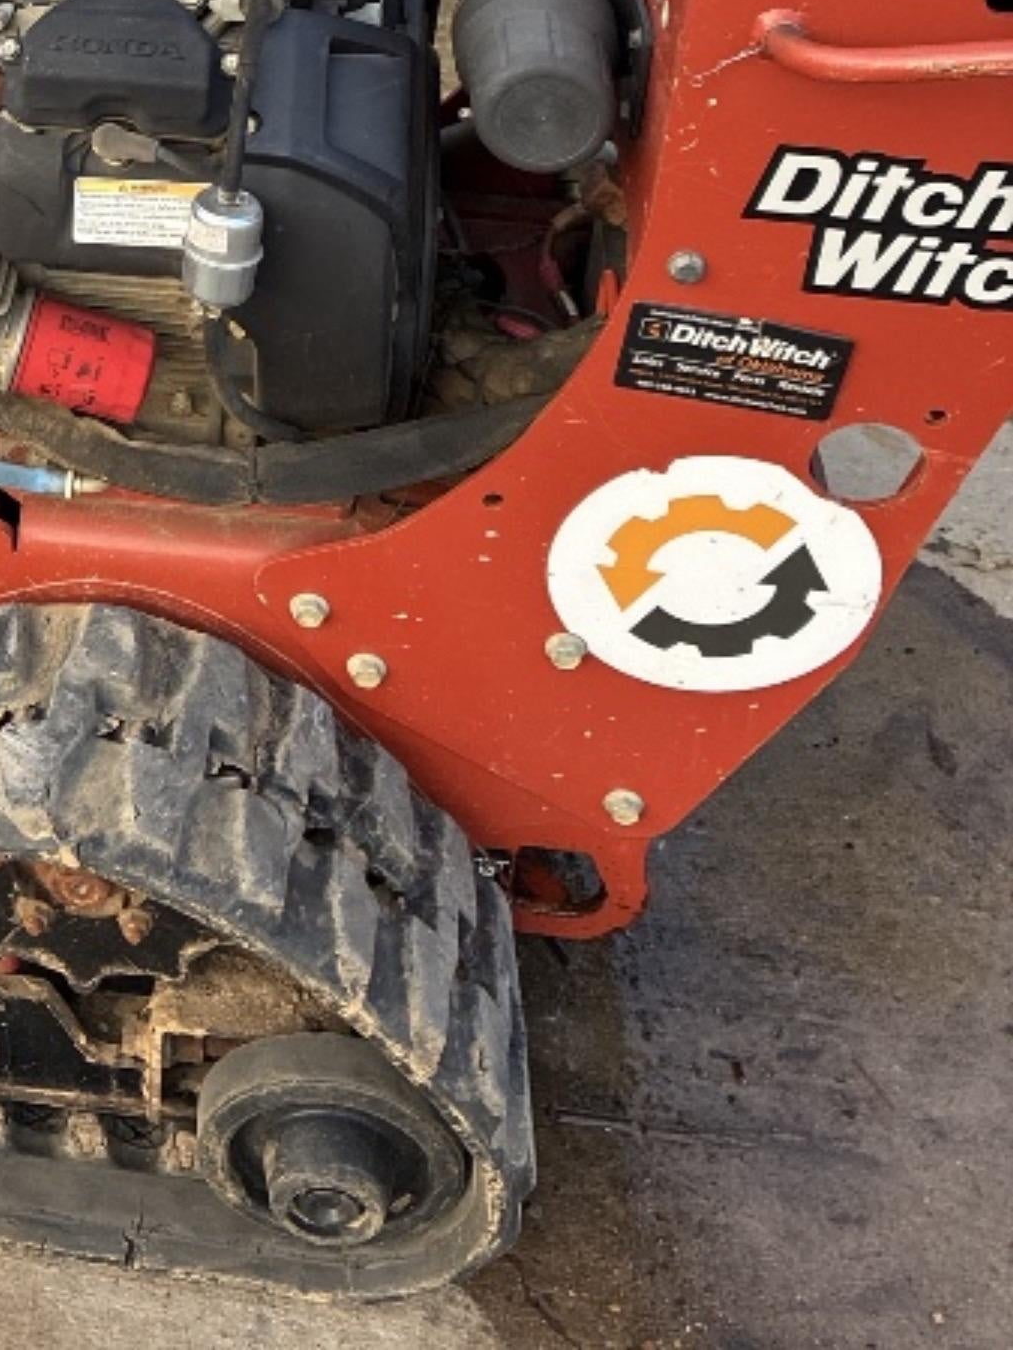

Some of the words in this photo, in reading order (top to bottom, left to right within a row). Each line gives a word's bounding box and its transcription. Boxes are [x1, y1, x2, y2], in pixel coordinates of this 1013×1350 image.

[49, 35, 188, 61] HONDA
[756, 152, 1013, 232] Ditch
[813, 227, 1013, 303] Witc
